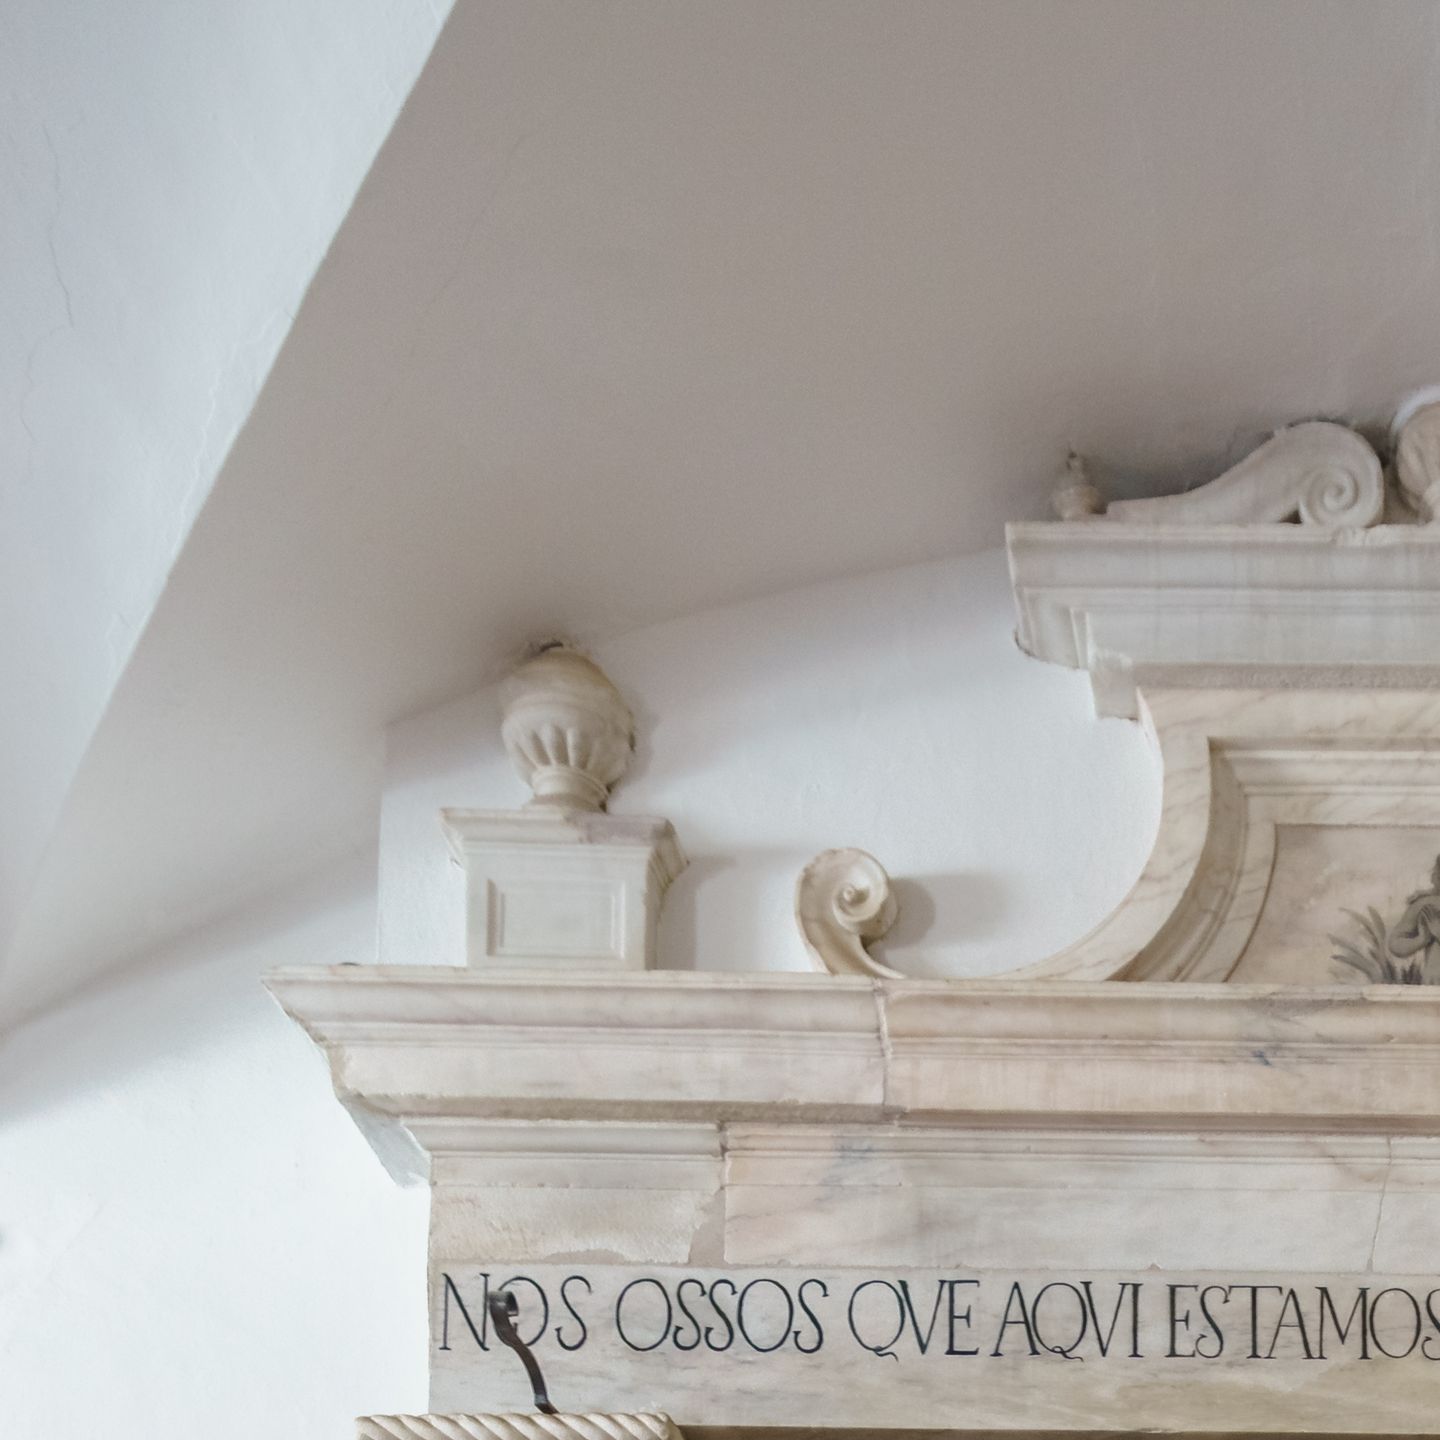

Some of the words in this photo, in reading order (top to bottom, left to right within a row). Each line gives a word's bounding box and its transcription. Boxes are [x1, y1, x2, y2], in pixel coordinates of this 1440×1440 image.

[438, 1273, 592, 1352] NOS
[616, 1277, 829, 1357] OSSOS
[848, 1279, 982, 1361] QVE
[991, 1281, 1144, 1363] AQVI
